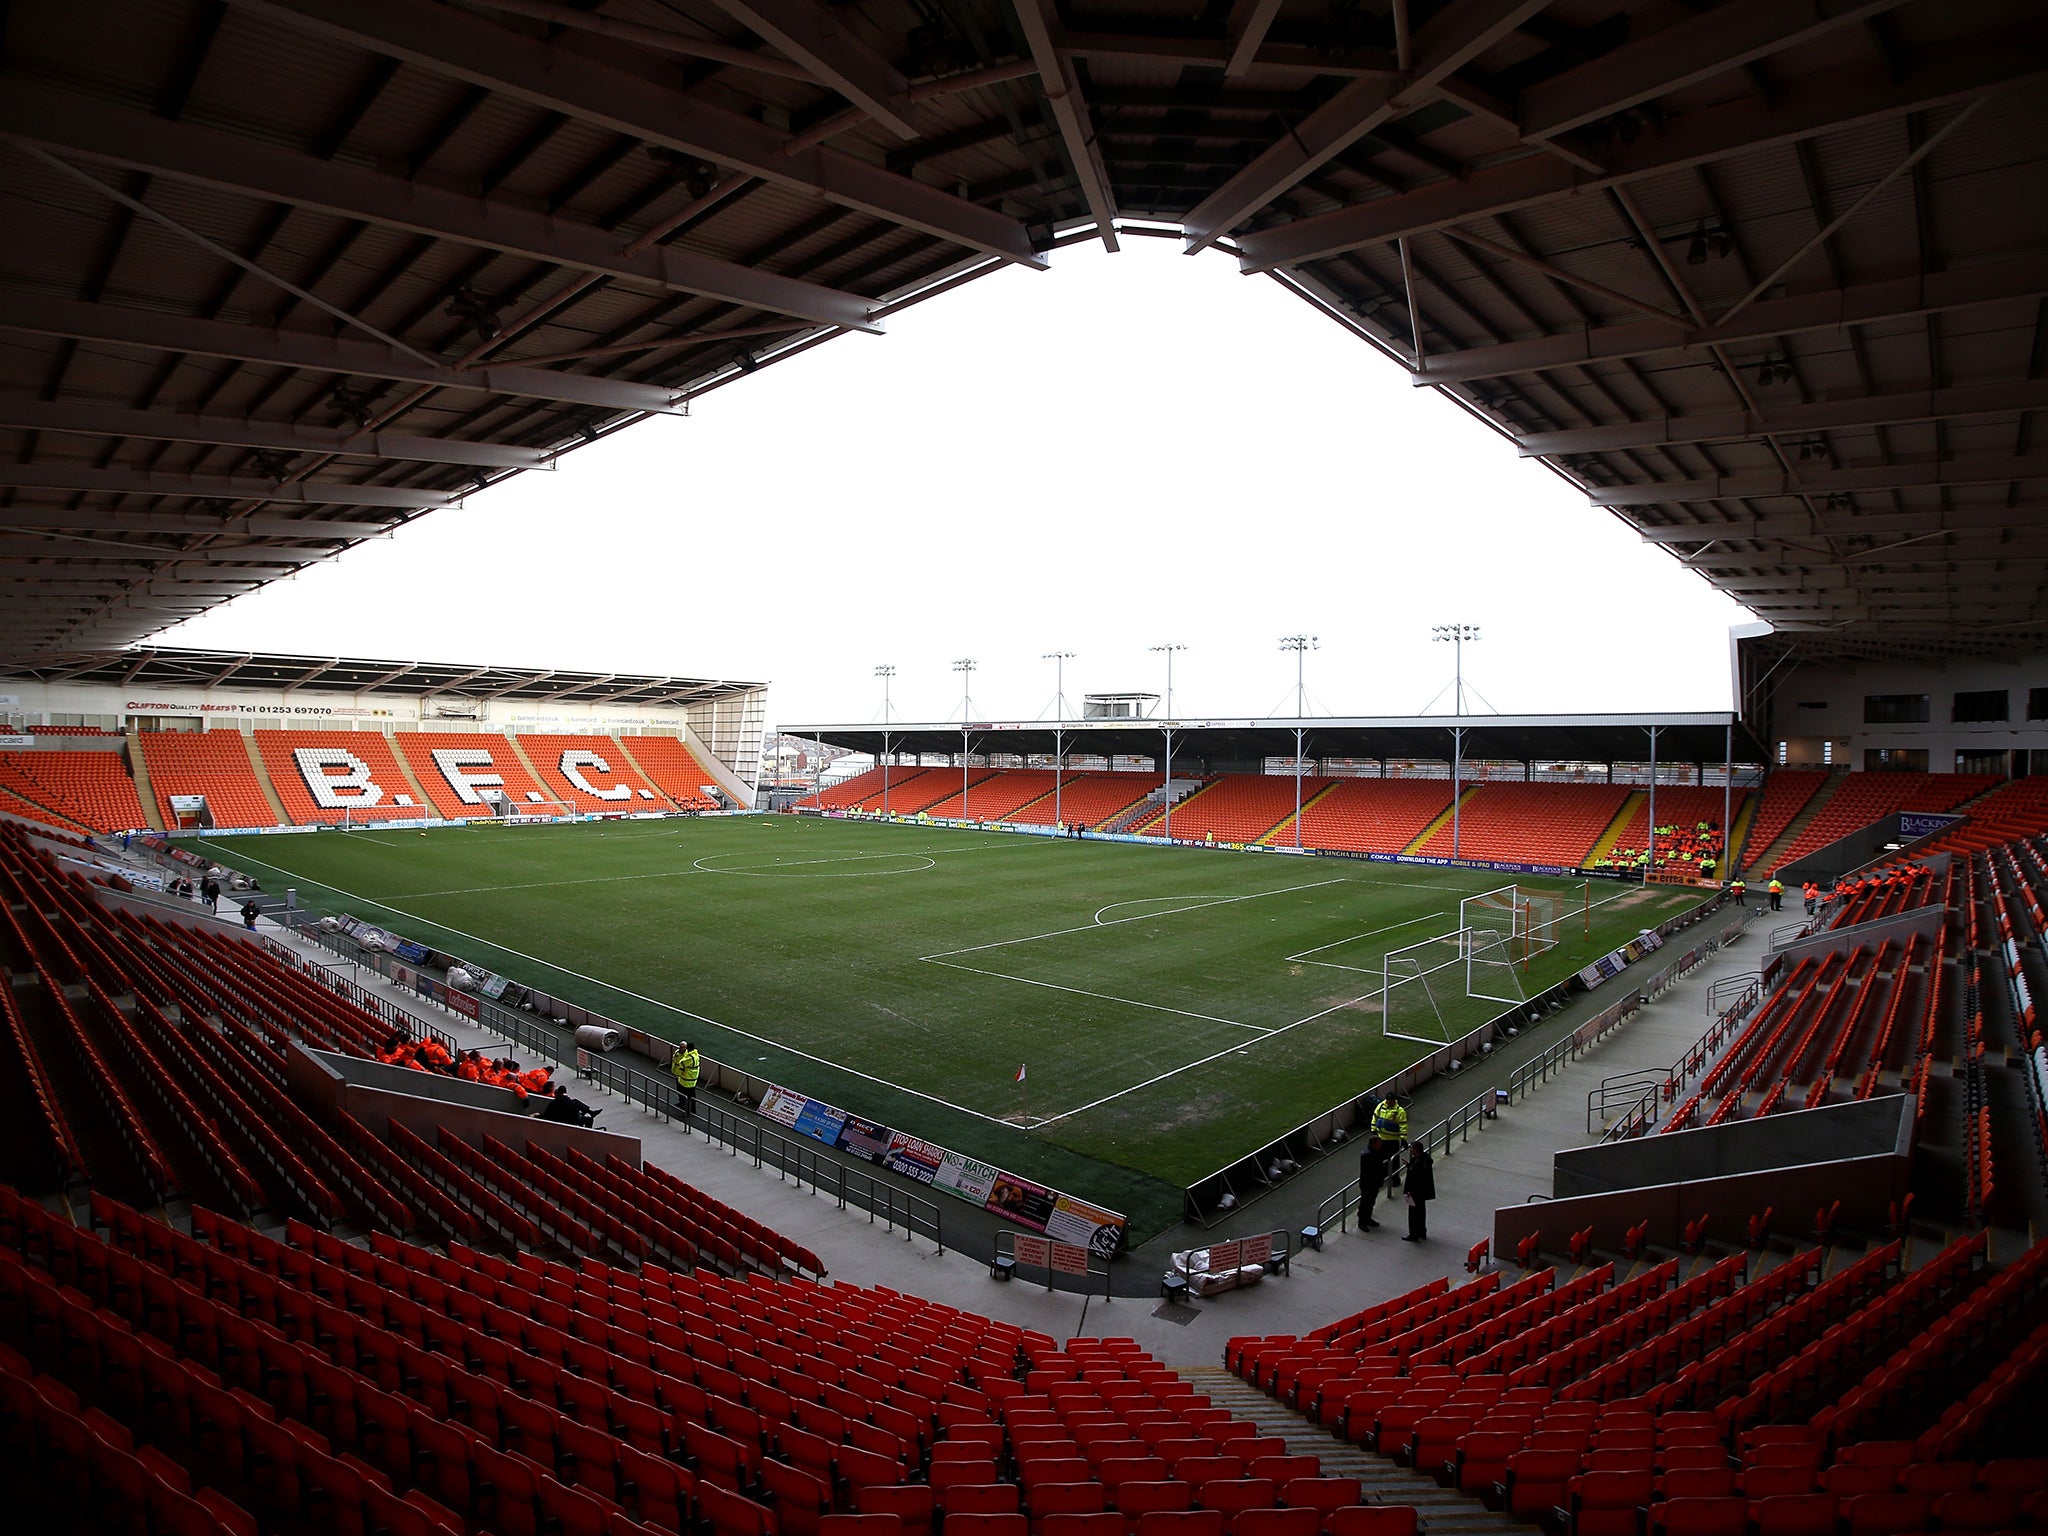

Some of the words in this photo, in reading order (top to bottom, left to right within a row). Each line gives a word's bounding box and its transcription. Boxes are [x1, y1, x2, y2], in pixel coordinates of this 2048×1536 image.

[127, 701, 169, 710] CLIFTON
[259, 706, 291, 714] 01253
[295, 707, 332, 715] 697070
[889, 816, 916, 825] bet365.com
[918, 818, 947, 827] bet365.com
[1901, 816, 1950, 831] BLACKPO
[949, 821, 979, 830] bet365.com
[982, 823, 1014, 833] bet365.com
[204, 827, 257, 836] wonga.com
[1019, 826, 1050, 835] wonga.com
[1093, 832, 1128, 841] wonga.com
[1134, 835, 1172, 844] wonga.com
[1218, 841, 1263, 852] bet365.com
[1324, 850, 1350, 858] SINGHA
[1370, 853, 1392, 861] CORAL
[1396, 855, 1425, 863] DOWNLOAD
[449, 990, 476, 1015] Ladbrokes
[895, 1133, 909, 1146] STOP
[908, 1138, 923, 1151] LOAN
[923, 1143, 945, 1159] SHARKS
[893, 1160, 908, 1173] 0300
[908, 1166, 919, 1177] 555
[917, 1169, 933, 1184] 2222
